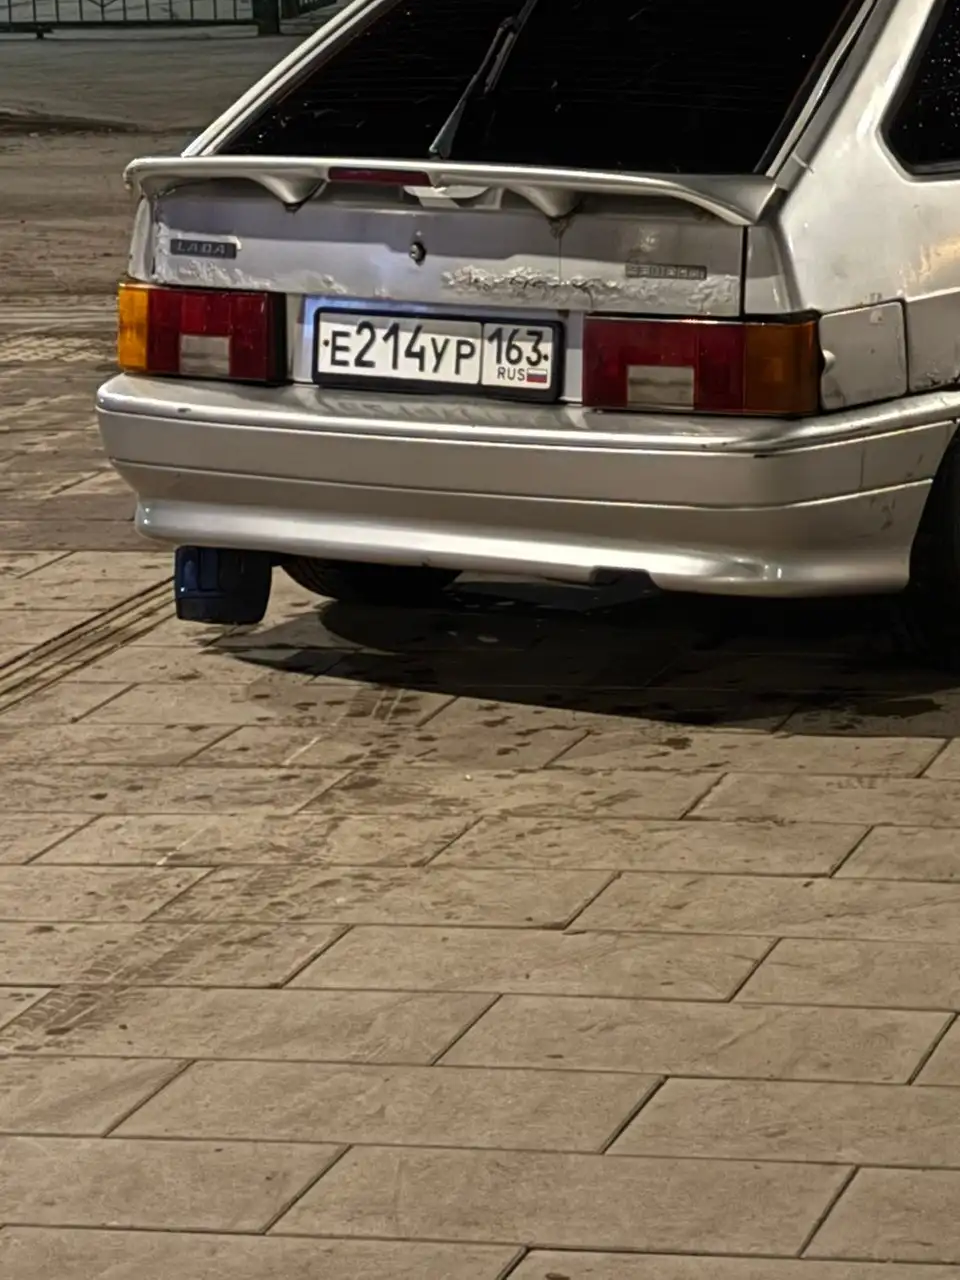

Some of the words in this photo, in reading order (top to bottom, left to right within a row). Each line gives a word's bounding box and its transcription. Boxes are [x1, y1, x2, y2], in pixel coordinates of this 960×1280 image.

[176, 240, 227, 255] LADA
[488, 327, 543, 367] 163
[497, 366, 525, 382] RUS
